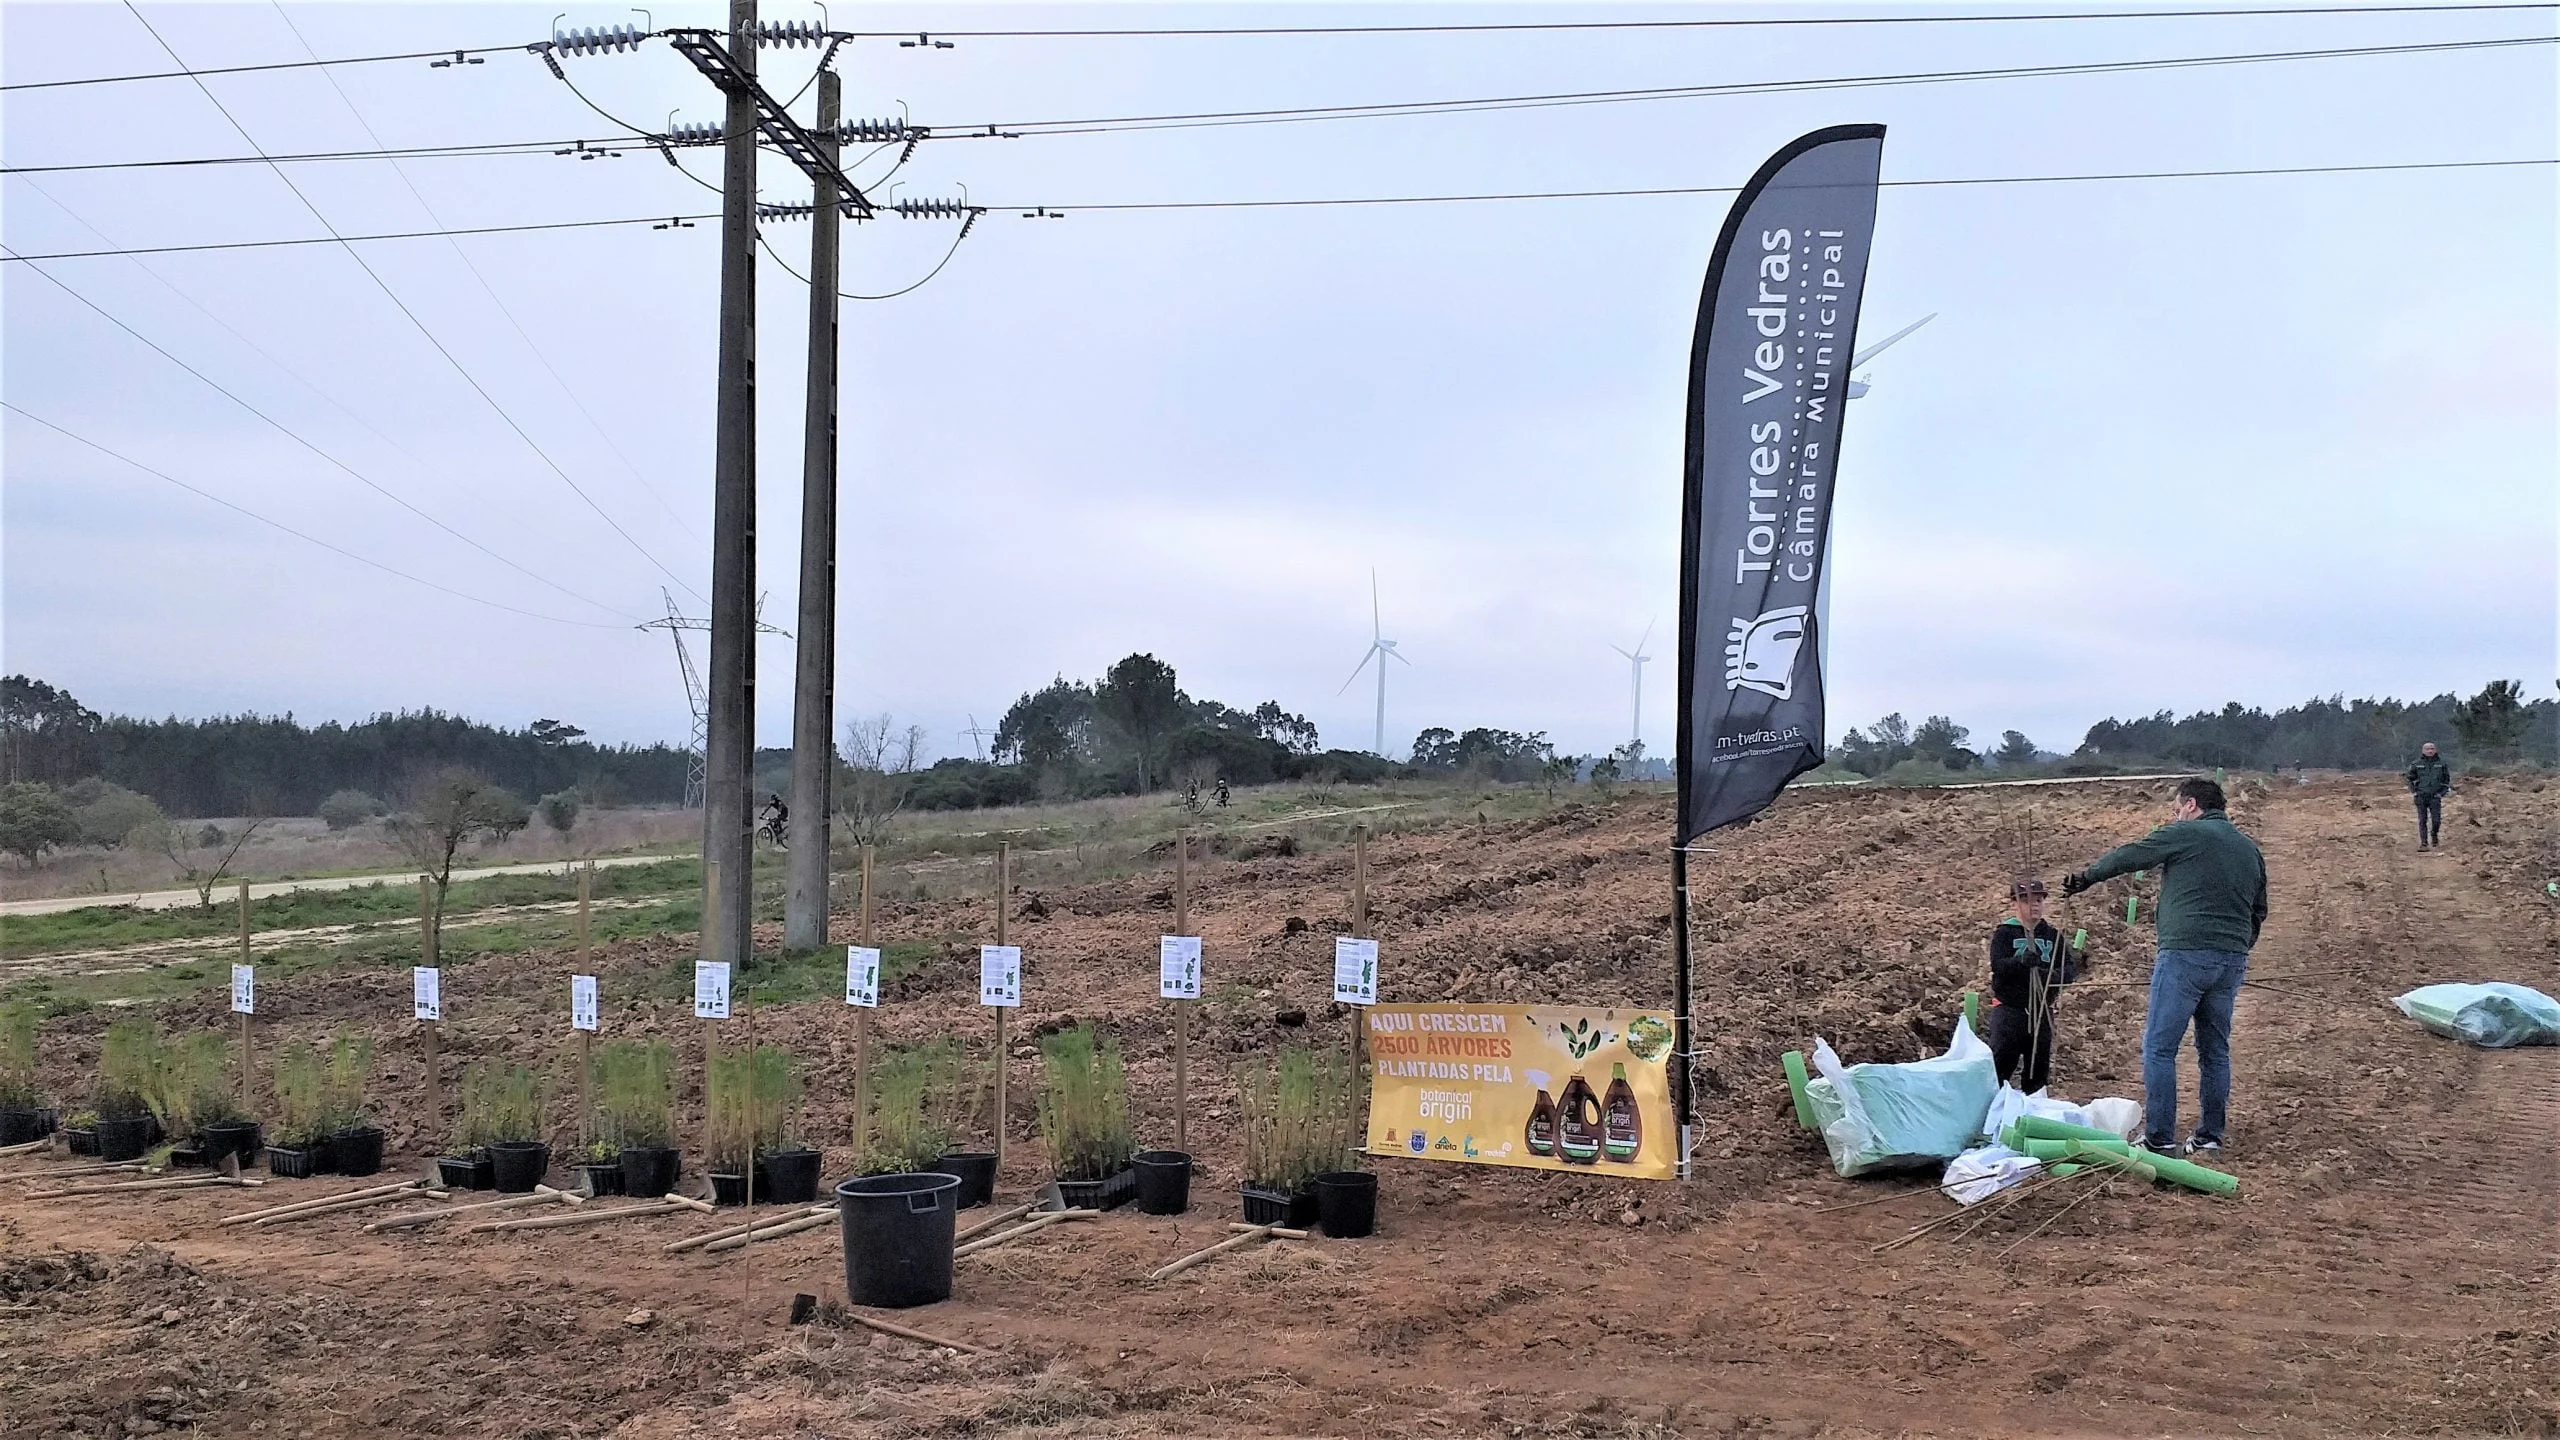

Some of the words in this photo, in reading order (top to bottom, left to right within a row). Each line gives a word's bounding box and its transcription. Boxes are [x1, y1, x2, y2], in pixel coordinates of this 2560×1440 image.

[1742, 227, 1792, 405] Vedras
[1787, 441, 1820, 583] Câmara
[1805, 229, 1845, 423] Municipal
[1736, 420, 1782, 584] Torres
[1371, 1013, 1413, 1034] AQUI
[1419, 1013, 1507, 1033] CRESCEM
[1373, 1035, 1419, 1055] 2500
[1426, 1032, 1512, 1058] ÁRVORES
[1378, 1060, 1469, 1080] PLANTADAS
[1473, 1064, 1513, 1083] PELA
[1420, 1088, 1472, 1105] botanical
[1420, 1101, 1472, 1124] origin
